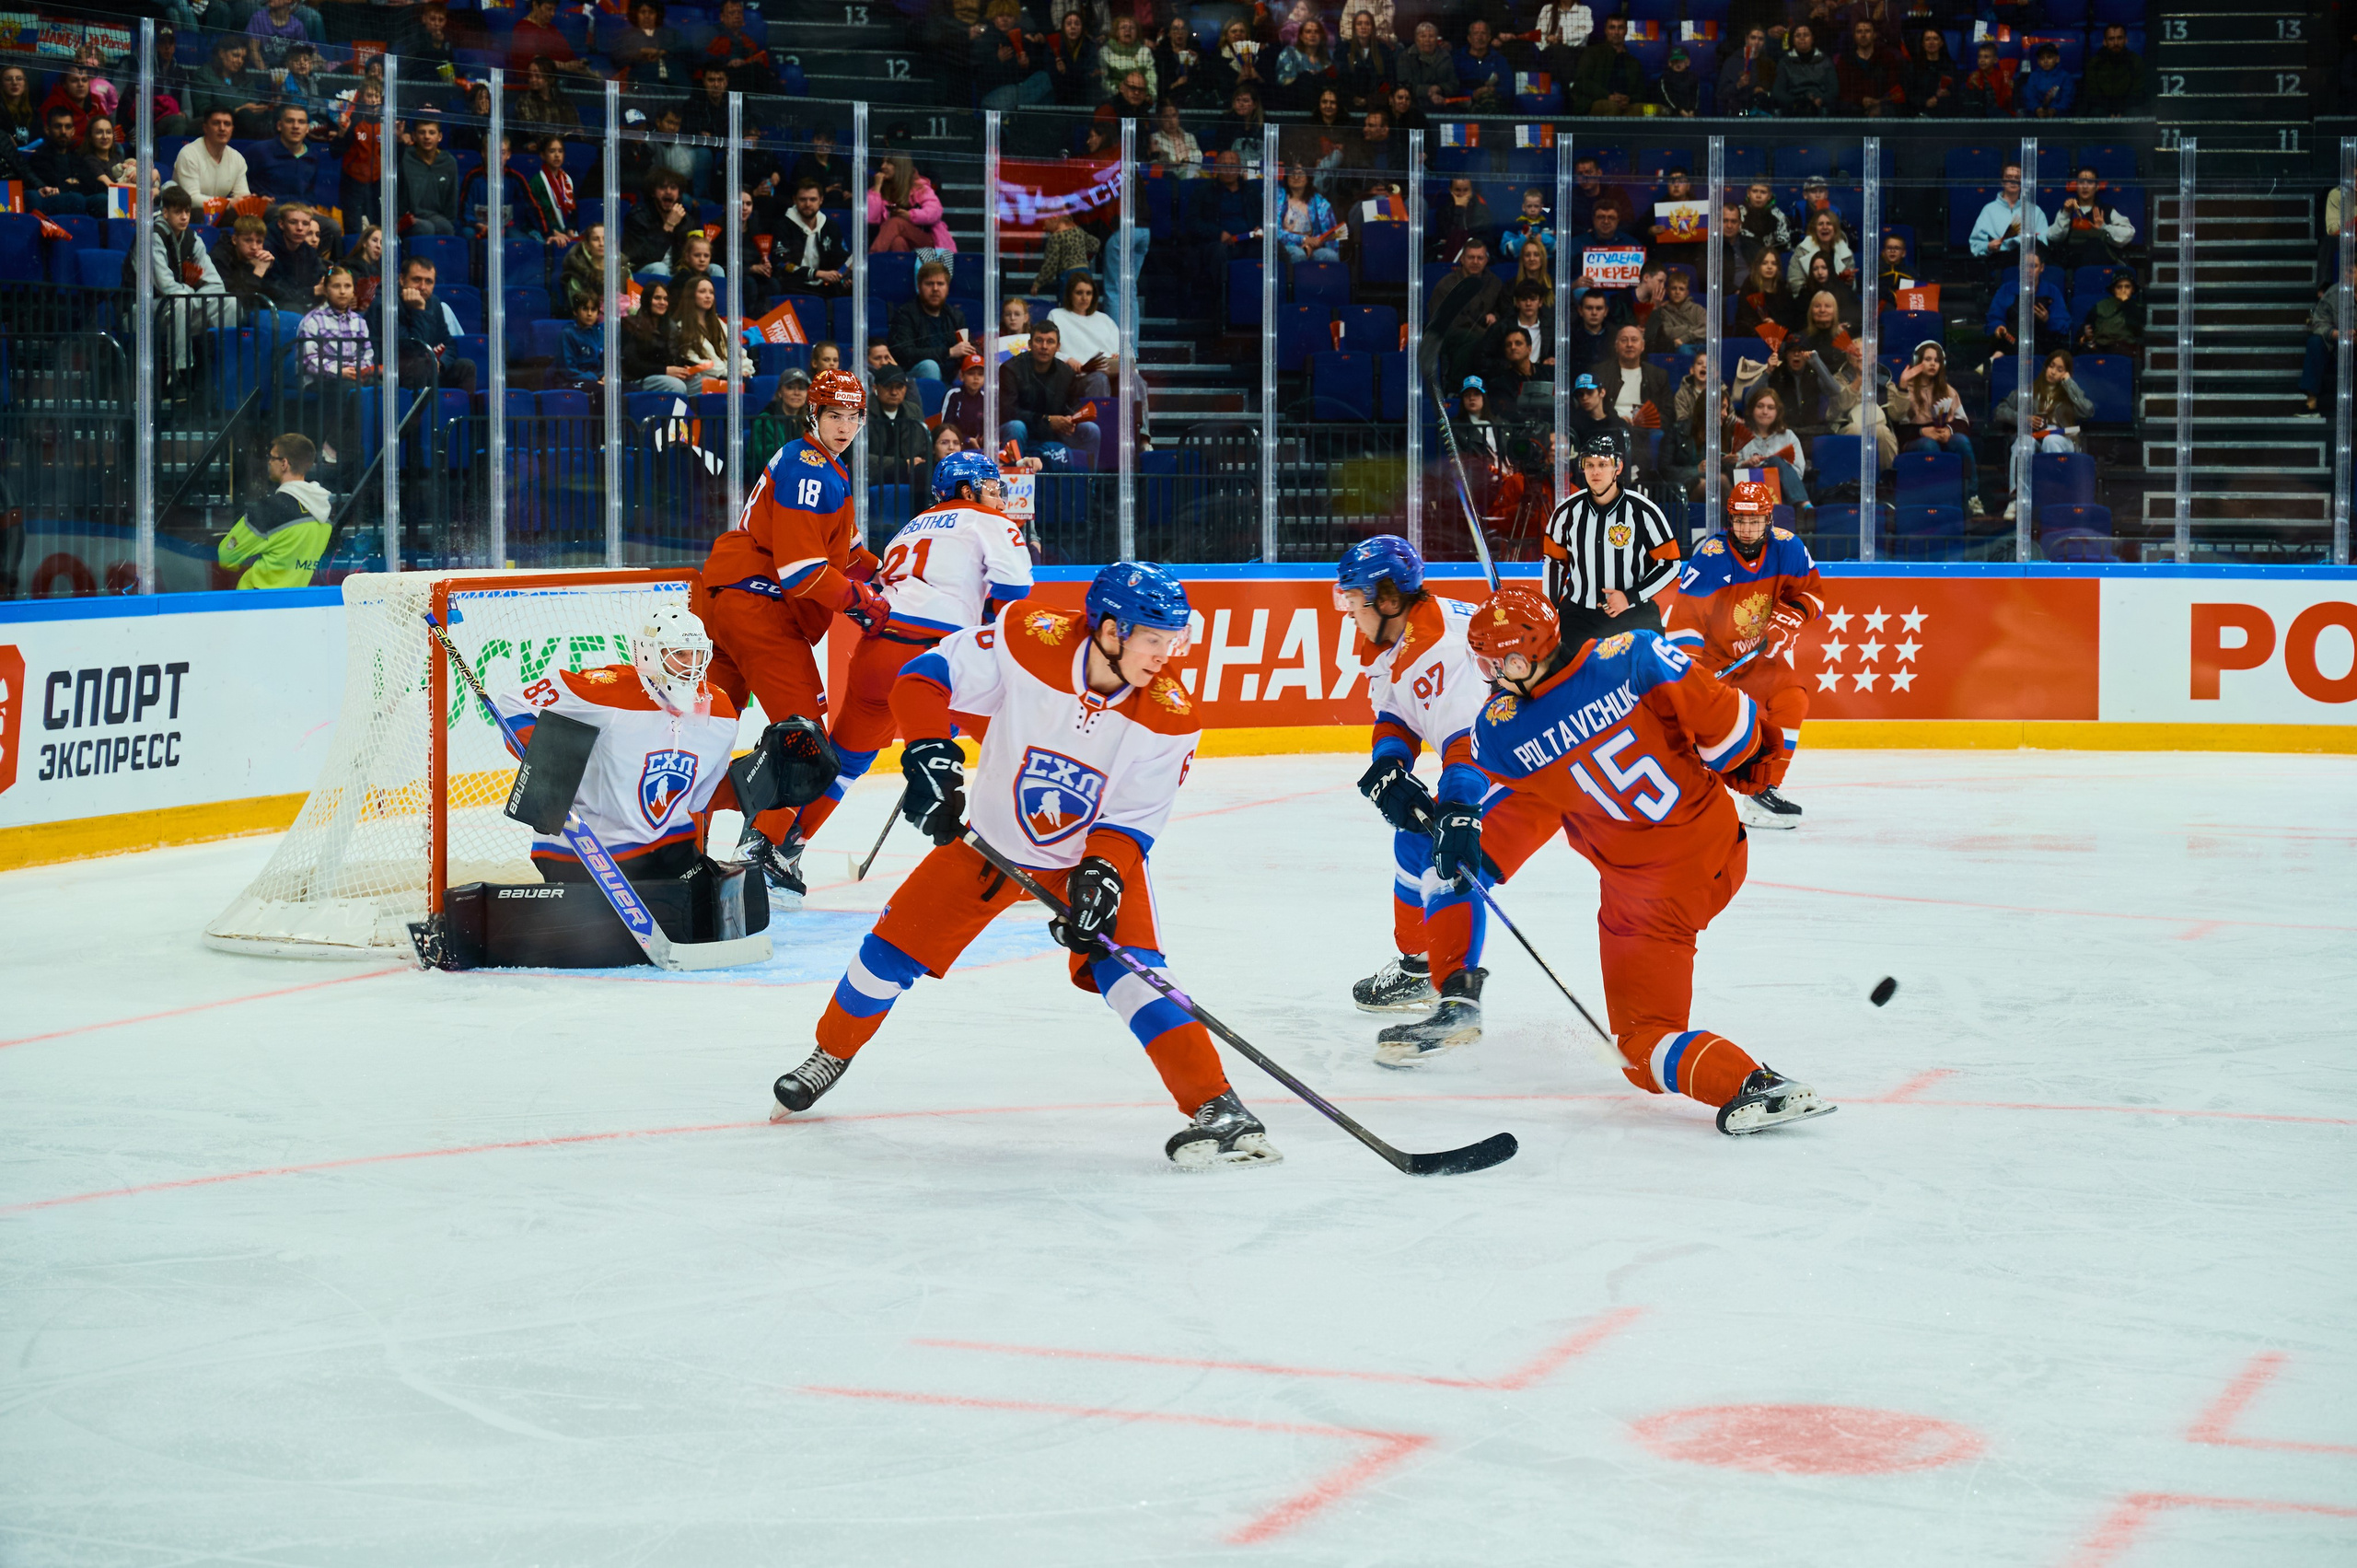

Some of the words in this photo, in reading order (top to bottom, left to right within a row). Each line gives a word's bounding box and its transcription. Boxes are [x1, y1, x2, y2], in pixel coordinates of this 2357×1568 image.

[844, 6, 868, 26] 13
[2164, 20, 2189, 40] 13
[2276, 19, 2302, 39] 13
[886, 59, 911, 79] 12
[2161, 75, 2186, 96] 12
[2276, 74, 2301, 93] 12
[2161, 129, 2180, 149] 11
[2279, 129, 2299, 151] 11
[797, 479, 822, 507] 18
[881, 538, 933, 587] 21
[1102, 597, 1122, 610] CCM
[430, 625, 486, 695] SHADOW
[1651, 634, 1691, 673] 15
[2189, 600, 2357, 704] РО
[42, 661, 190, 730] СПОРТ
[522, 678, 560, 707] 83
[1412, 661, 1446, 711] 97
[1513, 679, 1640, 772] POLTAVCHUK
[38, 731, 181, 782] ЭКСПРЕСС
[646, 751, 696, 777] СХЛ
[747, 749, 768, 784] BAUER
[508, 762, 532, 816] BAUER
[1025, 750, 1102, 803] СХЛ
[1369, 768, 1398, 803] CM
[1568, 726, 1682, 823] 15
[497, 888, 565, 900] BAUER
[574, 836, 648, 927] BAUER
